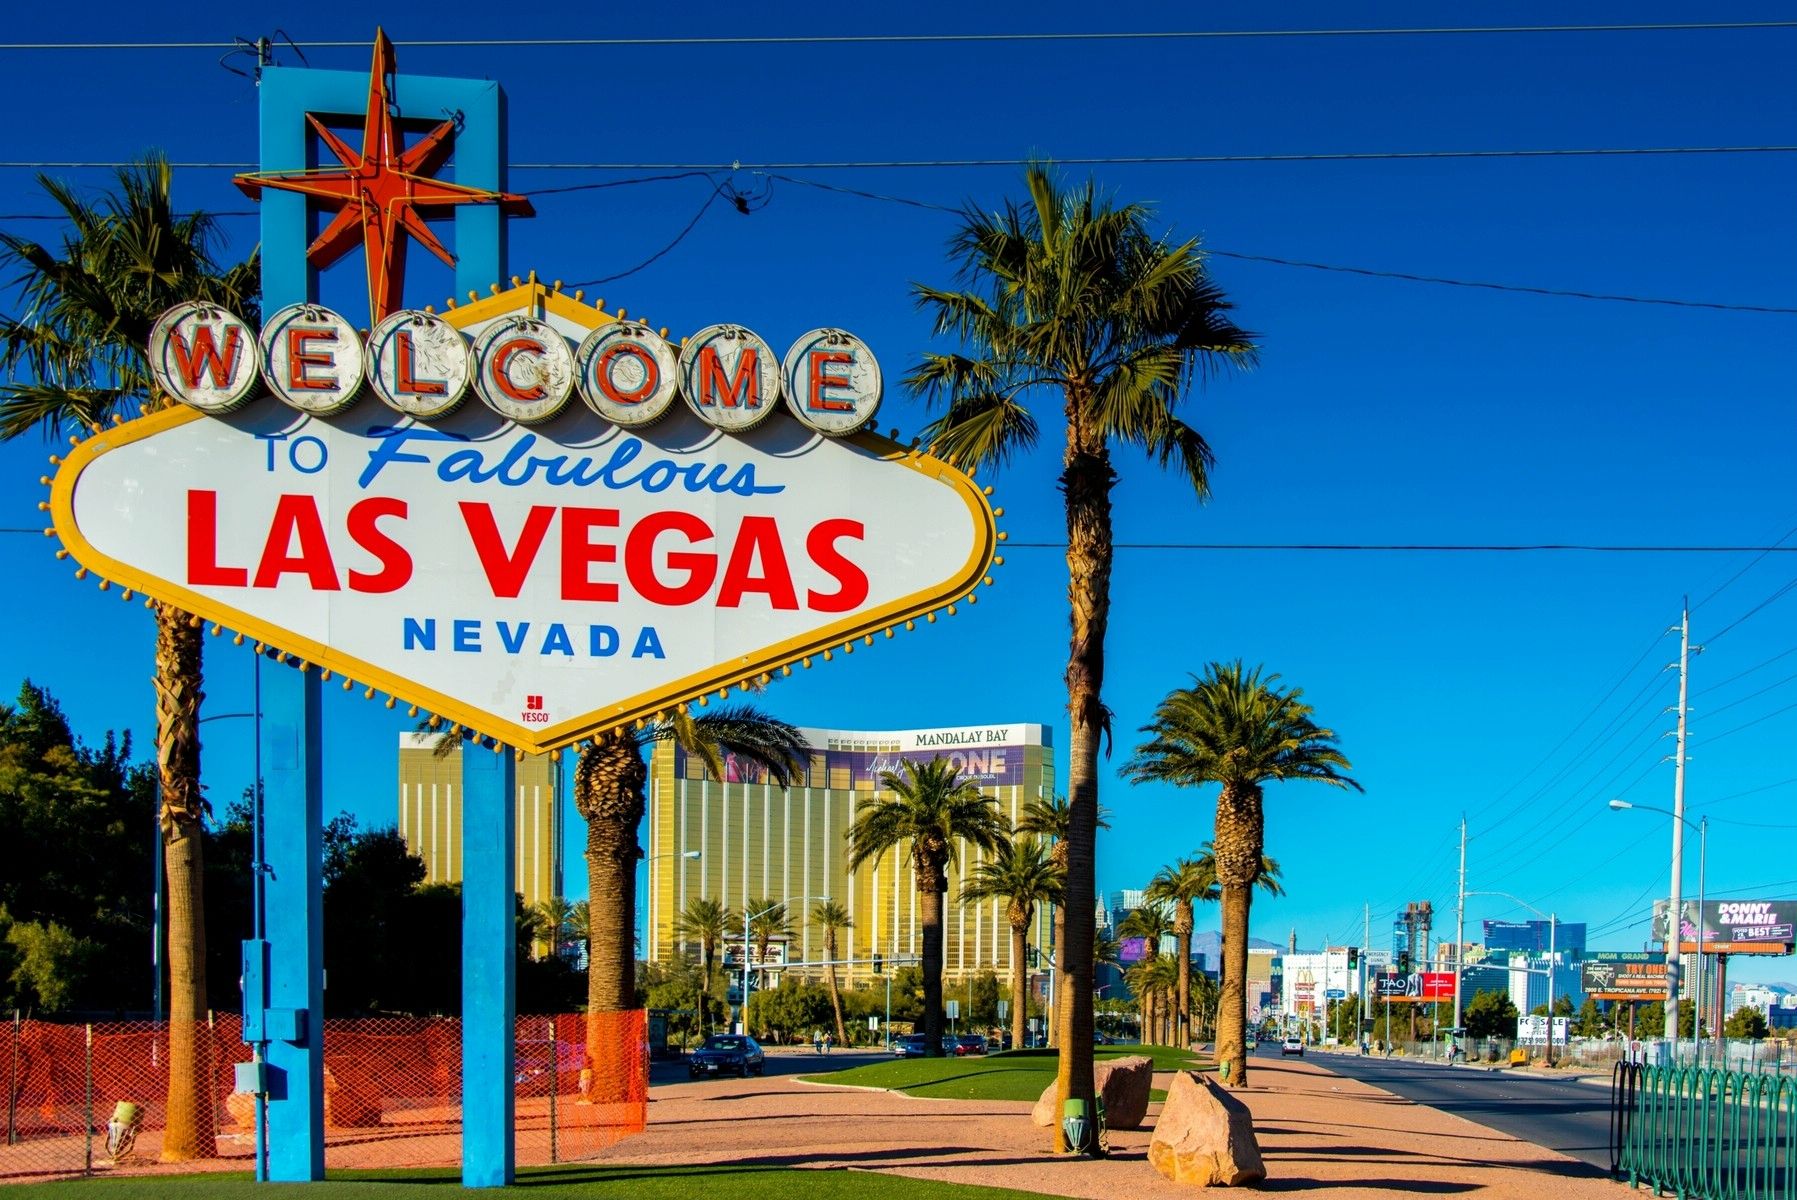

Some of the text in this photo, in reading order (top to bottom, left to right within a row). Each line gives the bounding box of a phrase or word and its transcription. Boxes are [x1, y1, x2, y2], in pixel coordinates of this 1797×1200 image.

[165, 322, 858, 415] WELCOME
[255, 425, 786, 497] TO Fabulous
[187, 489, 869, 613] LAS VEGAS
[403, 617, 667, 660] NEVADA
[521, 712, 549, 723] YESCO
[915, 729, 1009, 746] MANDALAY BAY
[944, 749, 1006, 774] ONE
[1718, 903, 1771, 914] DONNY
[1748, 927, 1770, 937] BEST
[1379, 979, 1406, 988] TAO
